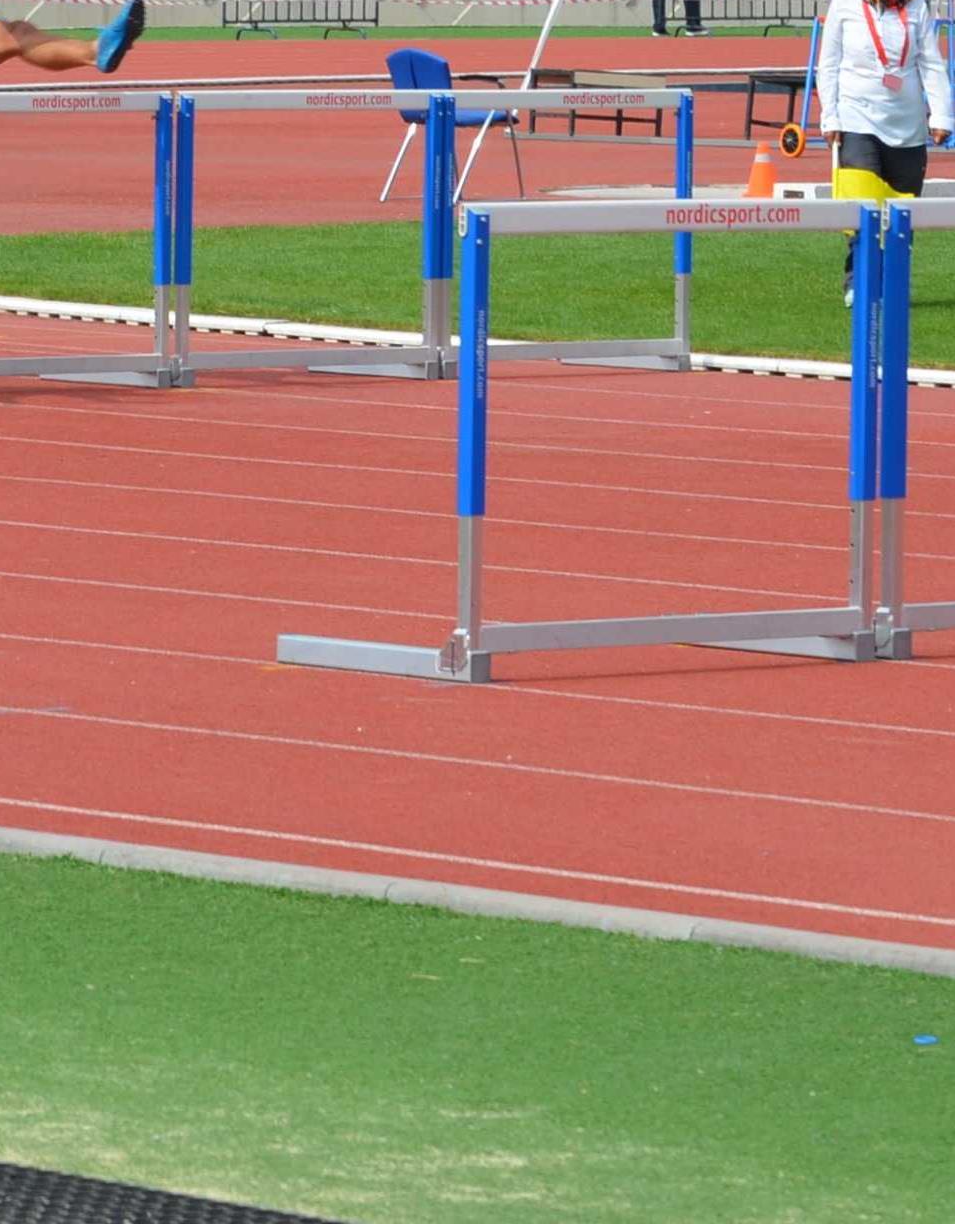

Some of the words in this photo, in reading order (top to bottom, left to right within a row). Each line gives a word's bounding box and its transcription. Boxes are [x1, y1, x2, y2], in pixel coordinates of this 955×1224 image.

[31, 95, 121, 111] nordicsport.com
[305, 93, 392, 109] nordicsport.com
[562, 91, 646, 107] nordicsport.com
[665, 203, 800, 227] nordicsport.com
